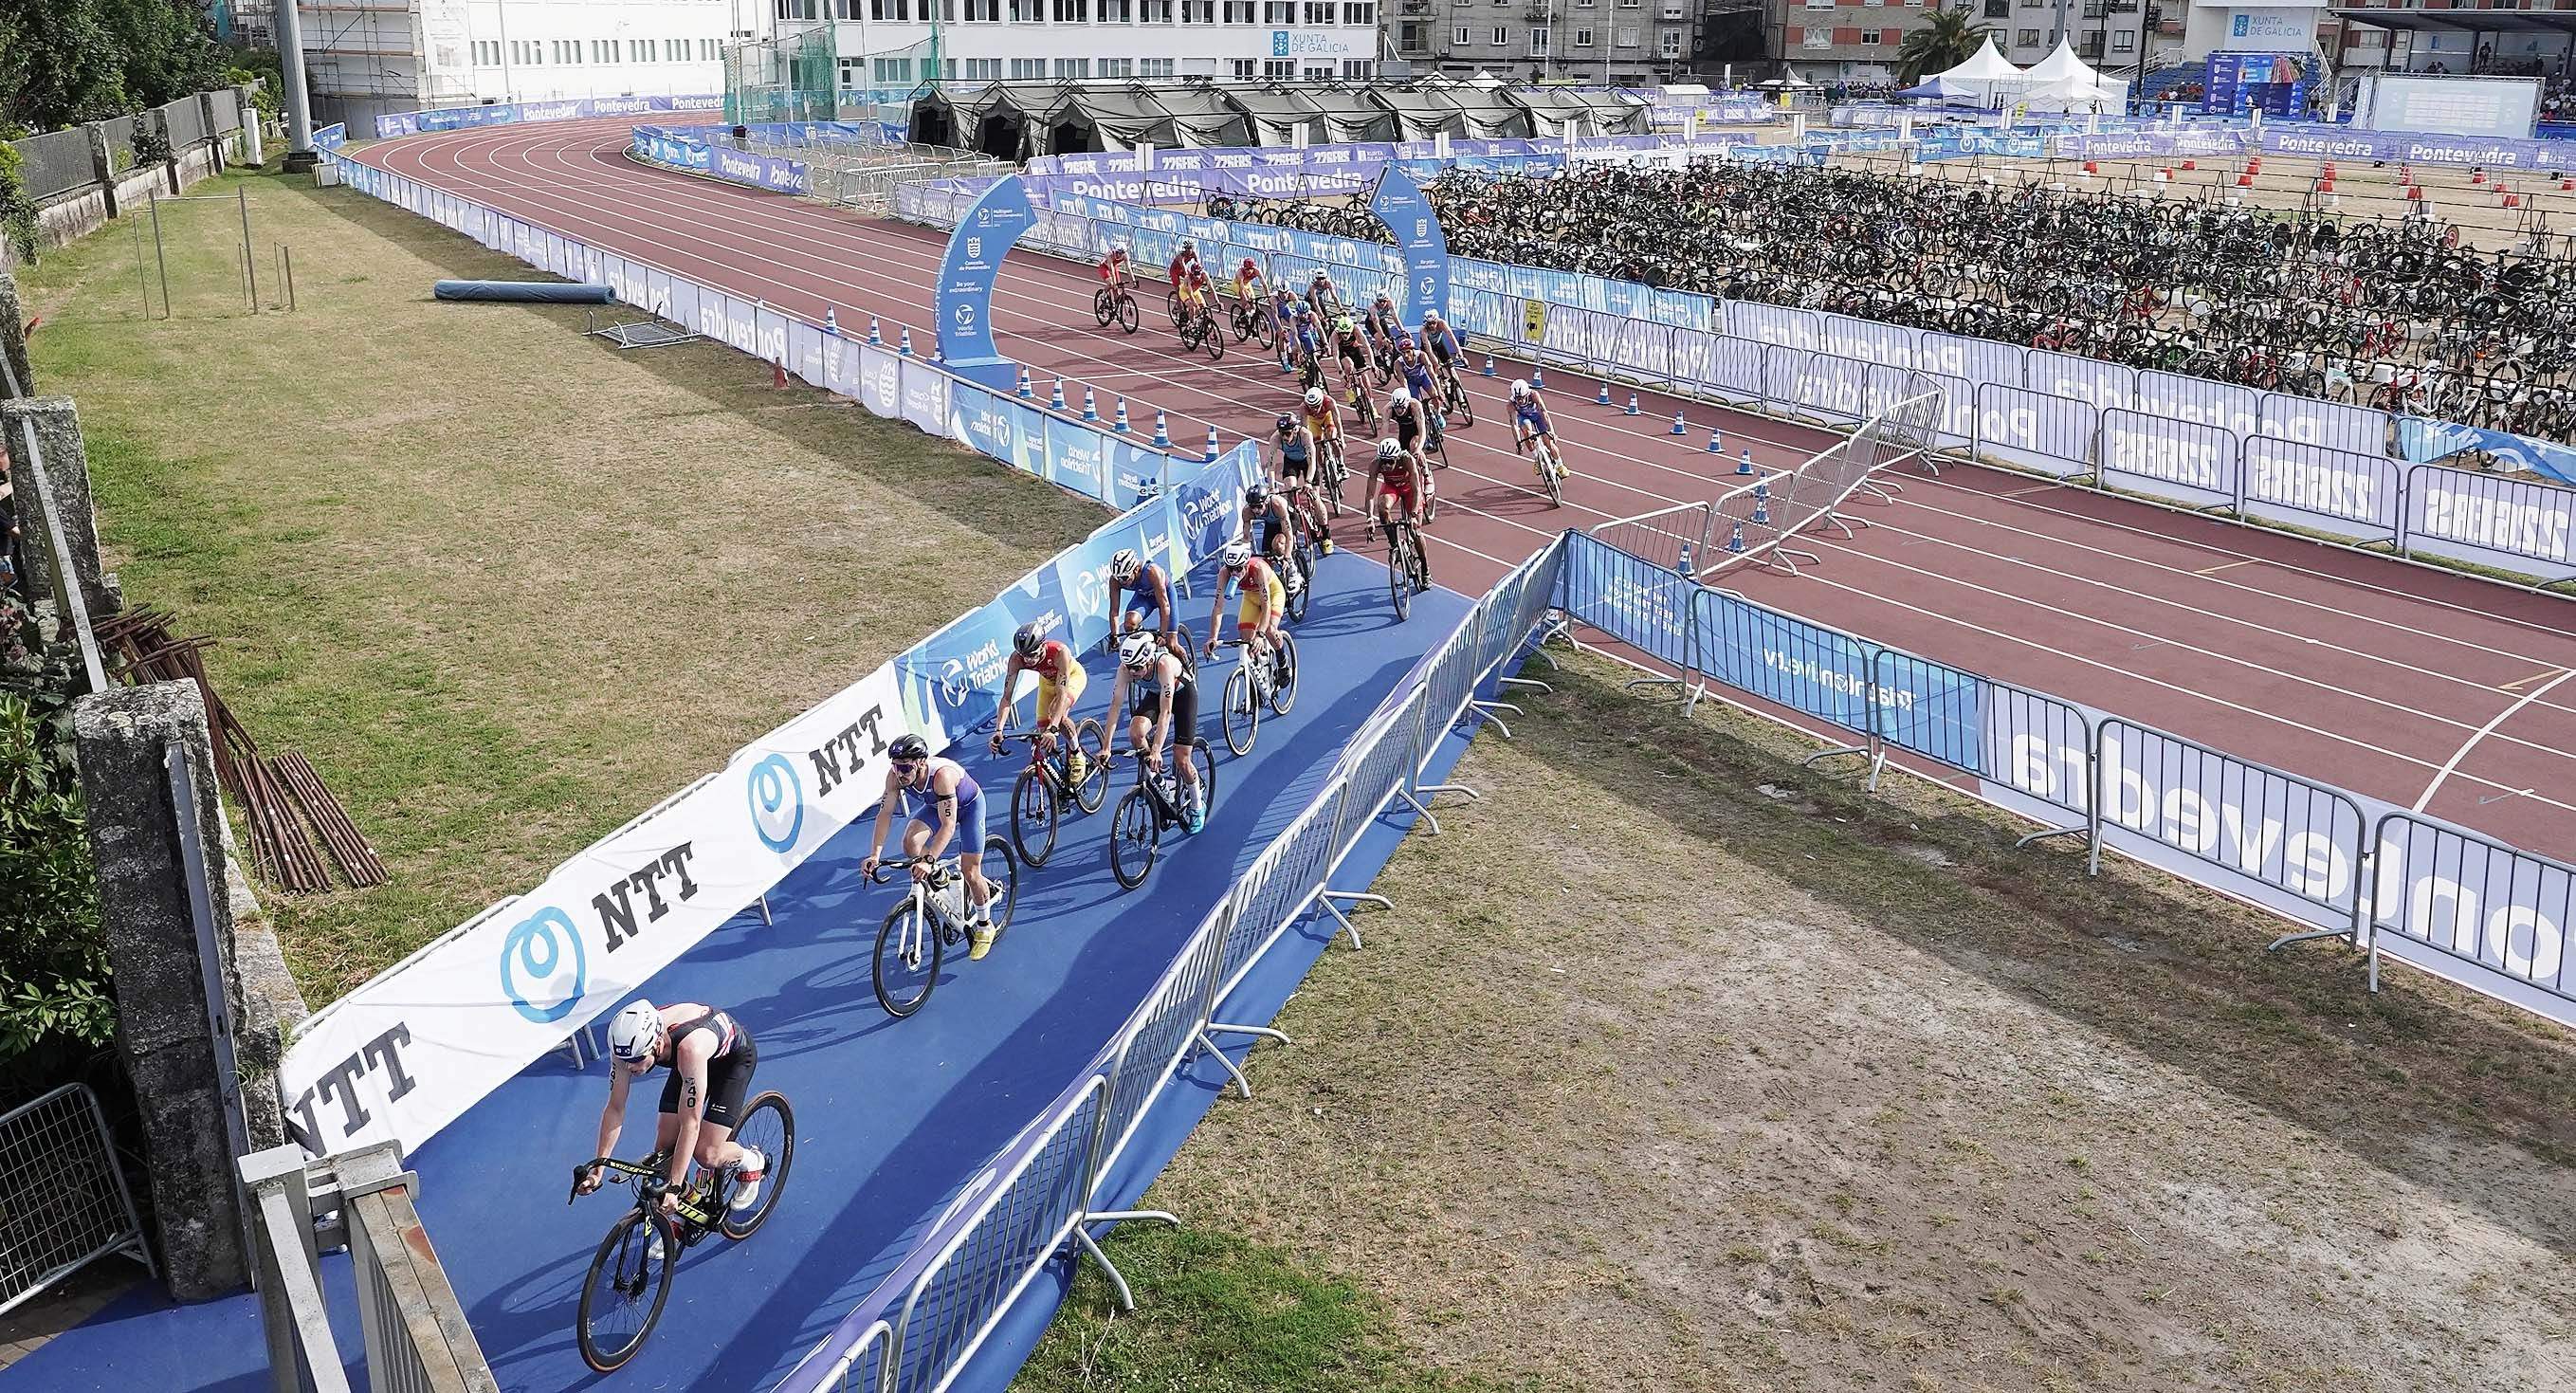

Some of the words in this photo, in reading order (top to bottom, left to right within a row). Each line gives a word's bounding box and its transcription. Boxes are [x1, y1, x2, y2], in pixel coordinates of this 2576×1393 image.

[2252, 16, 2283, 26] XUNTA
[1292, 33, 1327, 44] XUNTA
[2250, 26, 2262, 36] DE
[2264, 27, 2302, 37] GALICIA
[1291, 44, 1306, 53] DE
[1308, 44, 1349, 53] GALICIA
[594, 98, 650, 114] Pontevedra
[672, 97, 724, 111] Pontevedr
[522, 104, 576, 122] Pontevedra
[2086, 139, 2152, 155] Pontevedra
[2174, 137, 2238, 152] Pontevedra
[2278, 135, 2374, 156] Pontevedra
[1214, 154, 1252, 169] 226ERS
[1313, 150, 1351, 163] 226ERS
[2409, 143, 2518, 165] Pontevedra
[721, 153, 761, 181] Pontevedra
[1161, 156, 1202, 171] 226ERS
[1072, 174, 1200, 202] Pontevedra
[1247, 168, 1362, 194] Pontevedra
[935, 238, 957, 332] PONTEVEDRA
[965, 638, 1000, 671] World
[969, 655, 1010, 690] Triathlo
[808, 702, 888, 799] NTT
[592, 840, 699, 955] NTT
